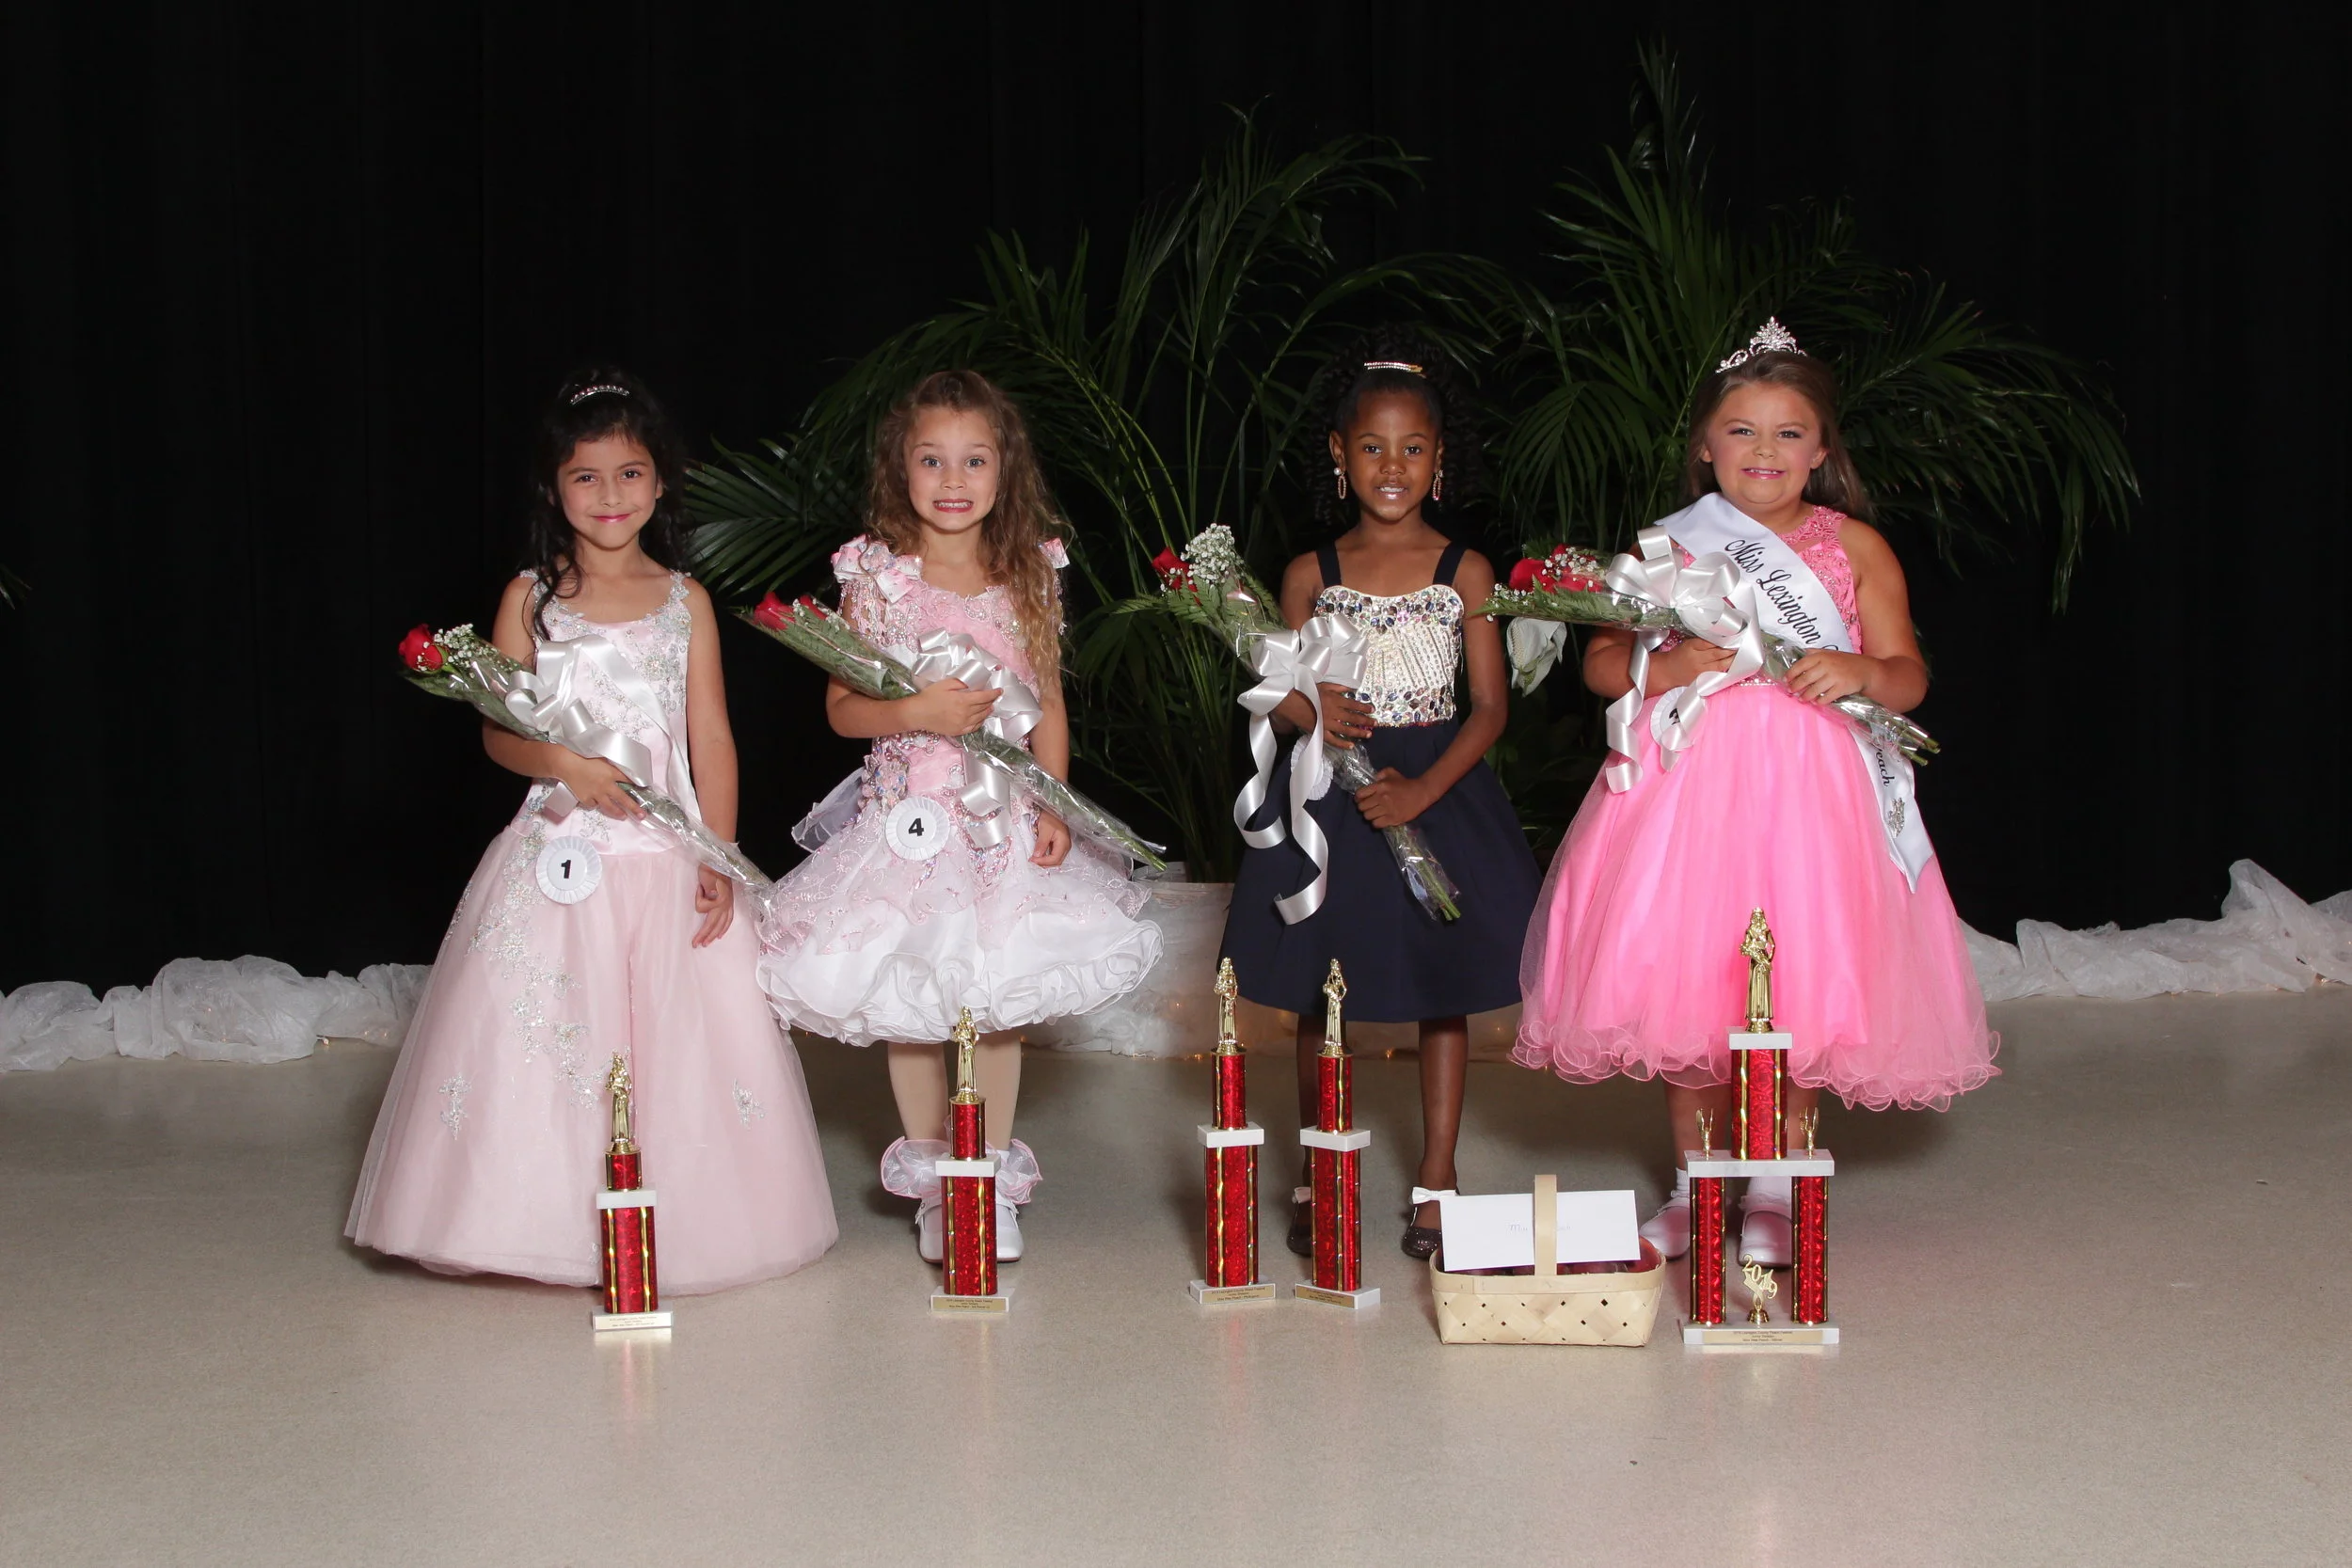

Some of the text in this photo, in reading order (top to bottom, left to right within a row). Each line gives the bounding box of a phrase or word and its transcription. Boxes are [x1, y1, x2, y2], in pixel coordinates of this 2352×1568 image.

[1724, 539, 1821, 645] Miss Lexington
[1876, 749, 1895, 786] each
[908, 817, 925, 837] 4
[561, 859, 572, 879] 1
[1741, 1253, 1778, 1299] 2019
